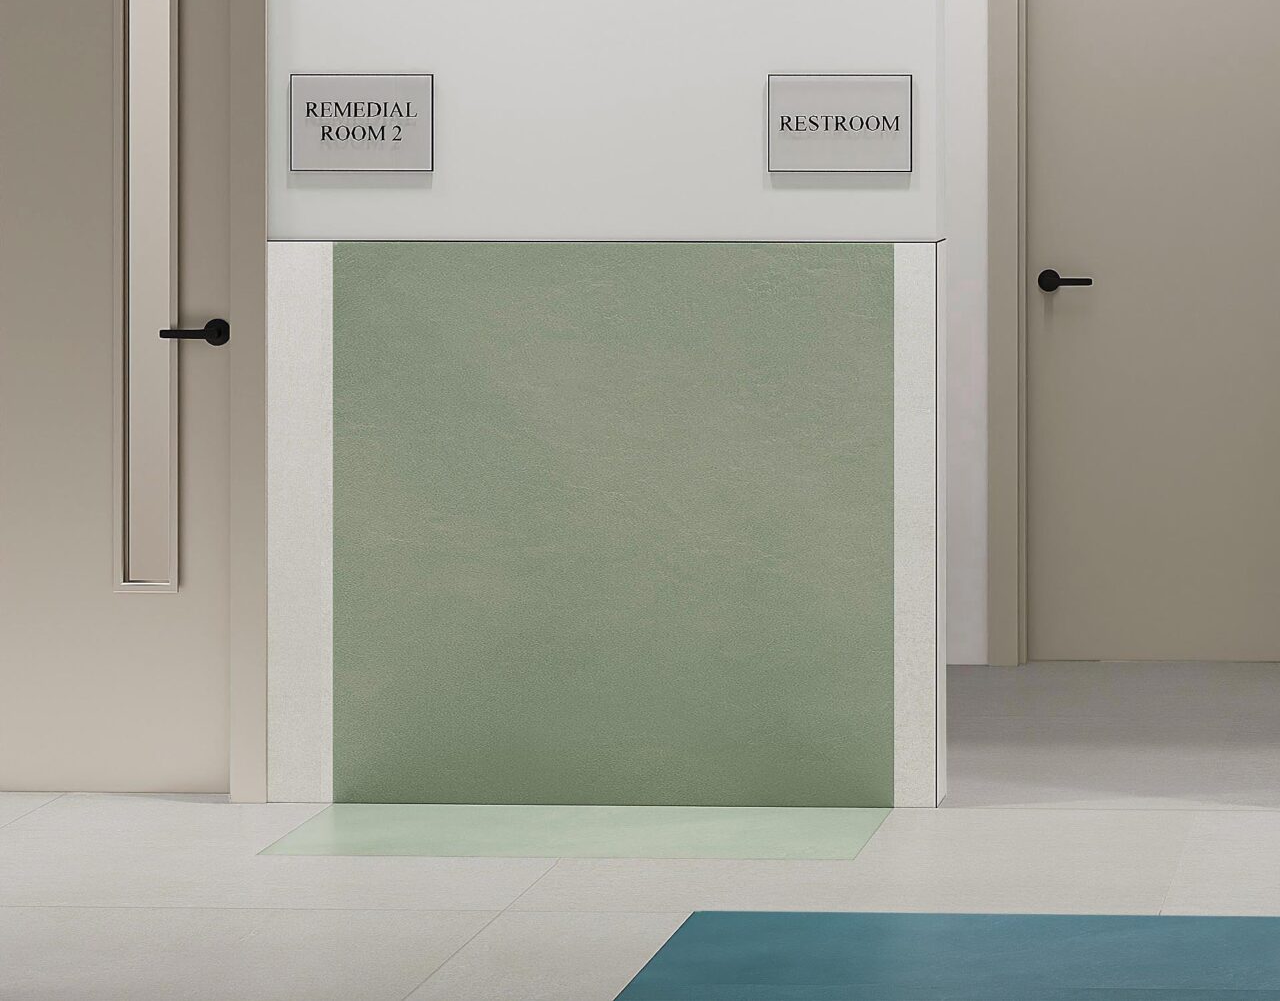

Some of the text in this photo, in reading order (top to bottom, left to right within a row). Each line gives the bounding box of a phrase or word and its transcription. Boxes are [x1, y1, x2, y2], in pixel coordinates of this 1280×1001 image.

[305, 101, 418, 118] REMEDIAL
[779, 115, 900, 132] RESTROOM
[320, 125, 403, 141] ROOM 2
